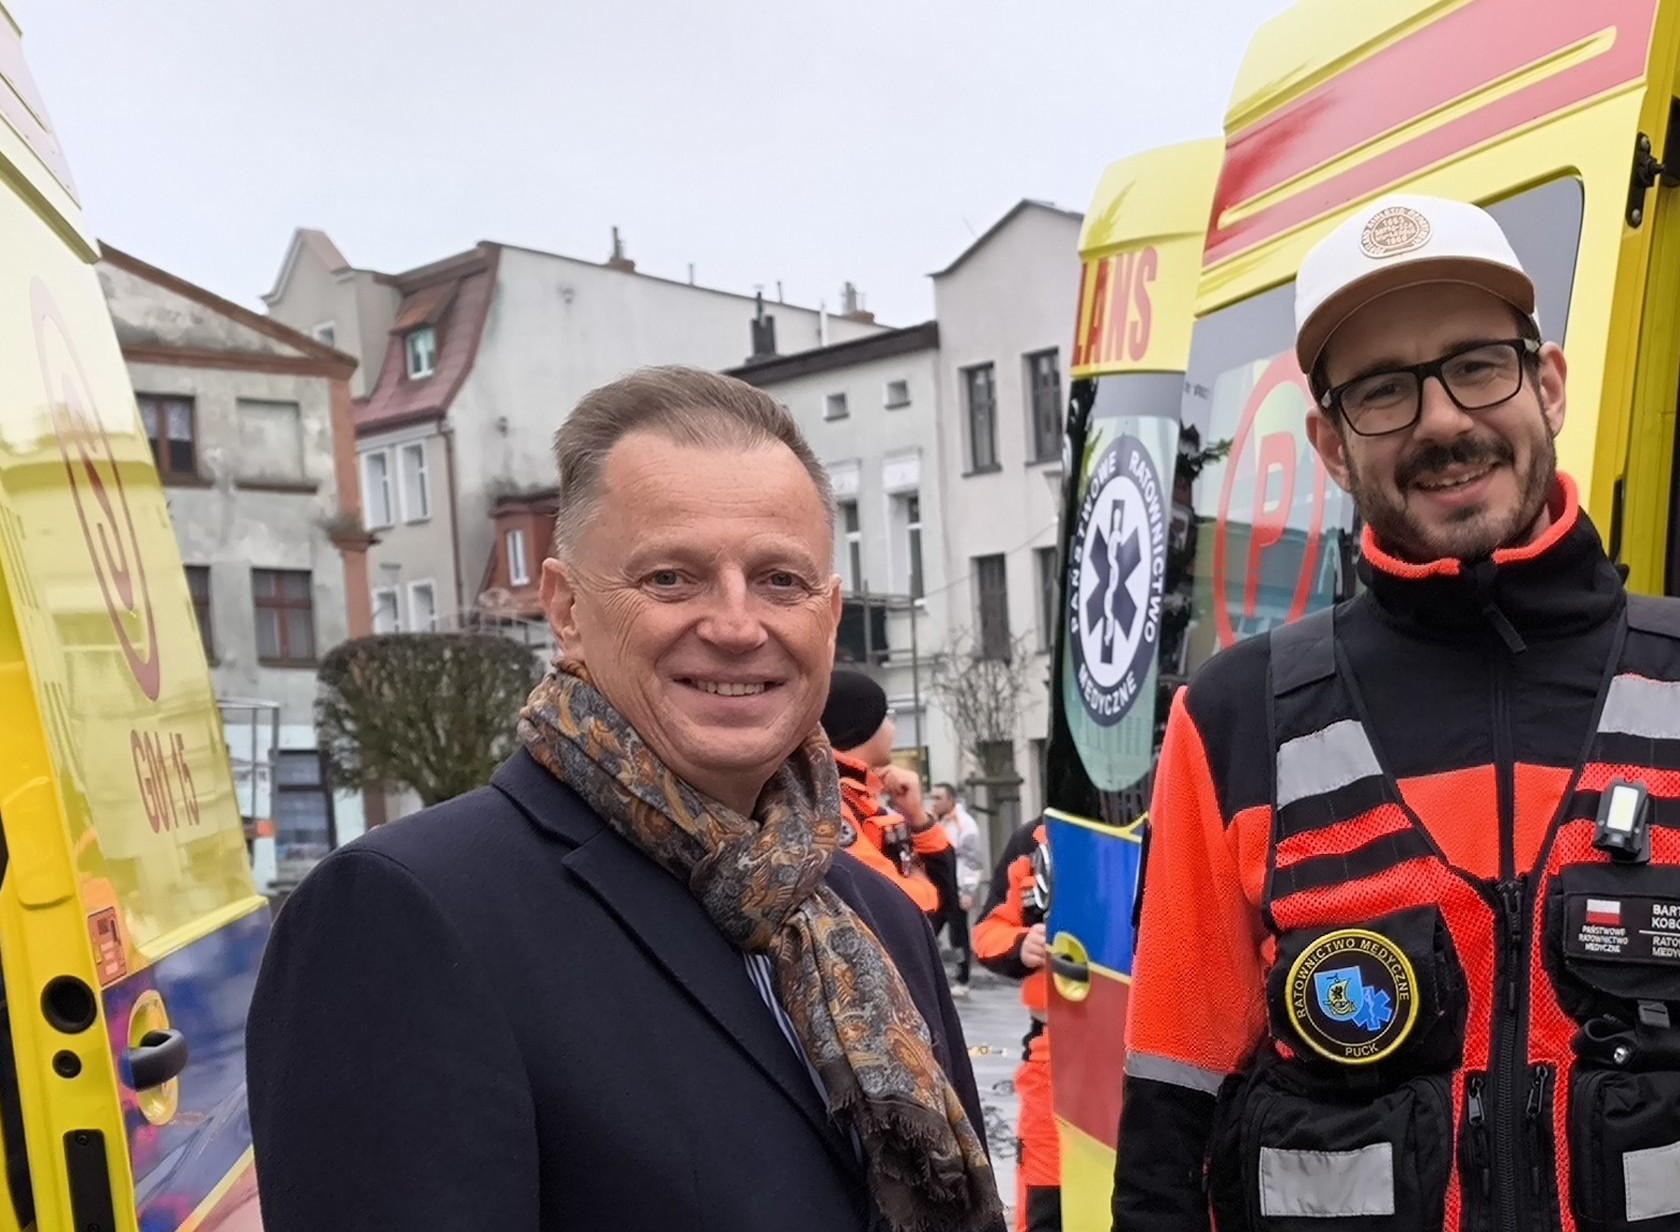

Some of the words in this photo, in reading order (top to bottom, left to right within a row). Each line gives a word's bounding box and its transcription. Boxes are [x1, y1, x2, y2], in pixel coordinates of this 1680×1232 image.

[1070, 245, 1158, 367] LANS
[1129, 450, 1165, 643] RATOWNICTWO
[1078, 663, 1138, 716] MEDYCZNE
[130, 728, 180, 834] G01
[1293, 938, 1356, 1019] RATOWNICTWO
[1359, 939, 1410, 1001] MEDYCZNE
[1345, 1043, 1379, 1058] PUCK
